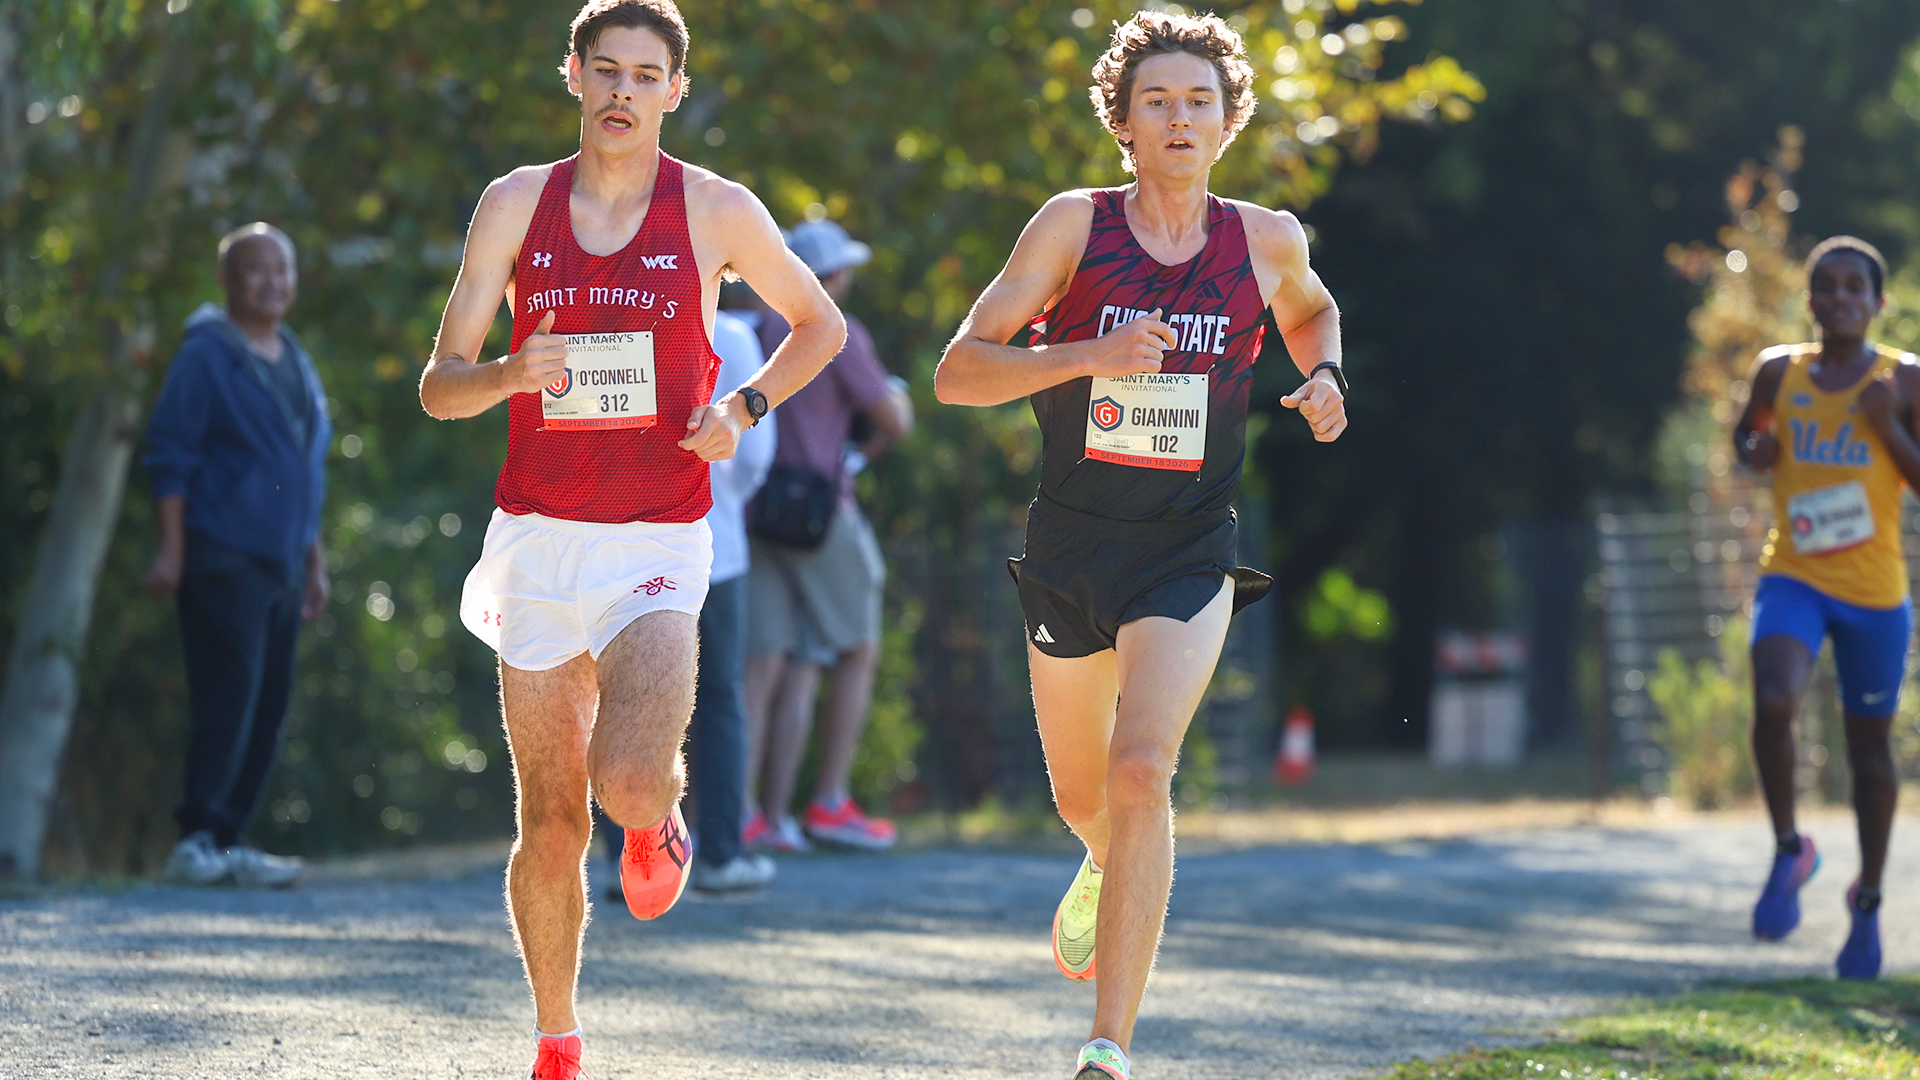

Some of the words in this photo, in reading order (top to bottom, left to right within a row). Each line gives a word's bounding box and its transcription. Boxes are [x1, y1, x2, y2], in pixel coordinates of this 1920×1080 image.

[640, 254, 679, 270] WCC
[526, 287, 578, 314] SAINT
[588, 287, 679, 319] MARY'S
[590, 333, 634, 344] MARY'S
[1163, 313, 1231, 355] STATE
[566, 345, 622, 353] NVITATIONAL
[579, 368, 648, 386] O'CONNELL
[1147, 375, 1191, 385] MARY'S
[1121, 384, 1178, 393] INVITATIONAL
[600, 393, 629, 413] 312
[558, 419, 606, 428] SEPTEMBER
[608, 419, 619, 427] 18
[621, 417, 642, 426] 2026
[1131, 407, 1200, 428] GIANNINI
[1151, 434, 1179, 453] 102
[1101, 452, 1153, 465] SEPTEMBER
[1166, 459, 1189, 468] 2026
